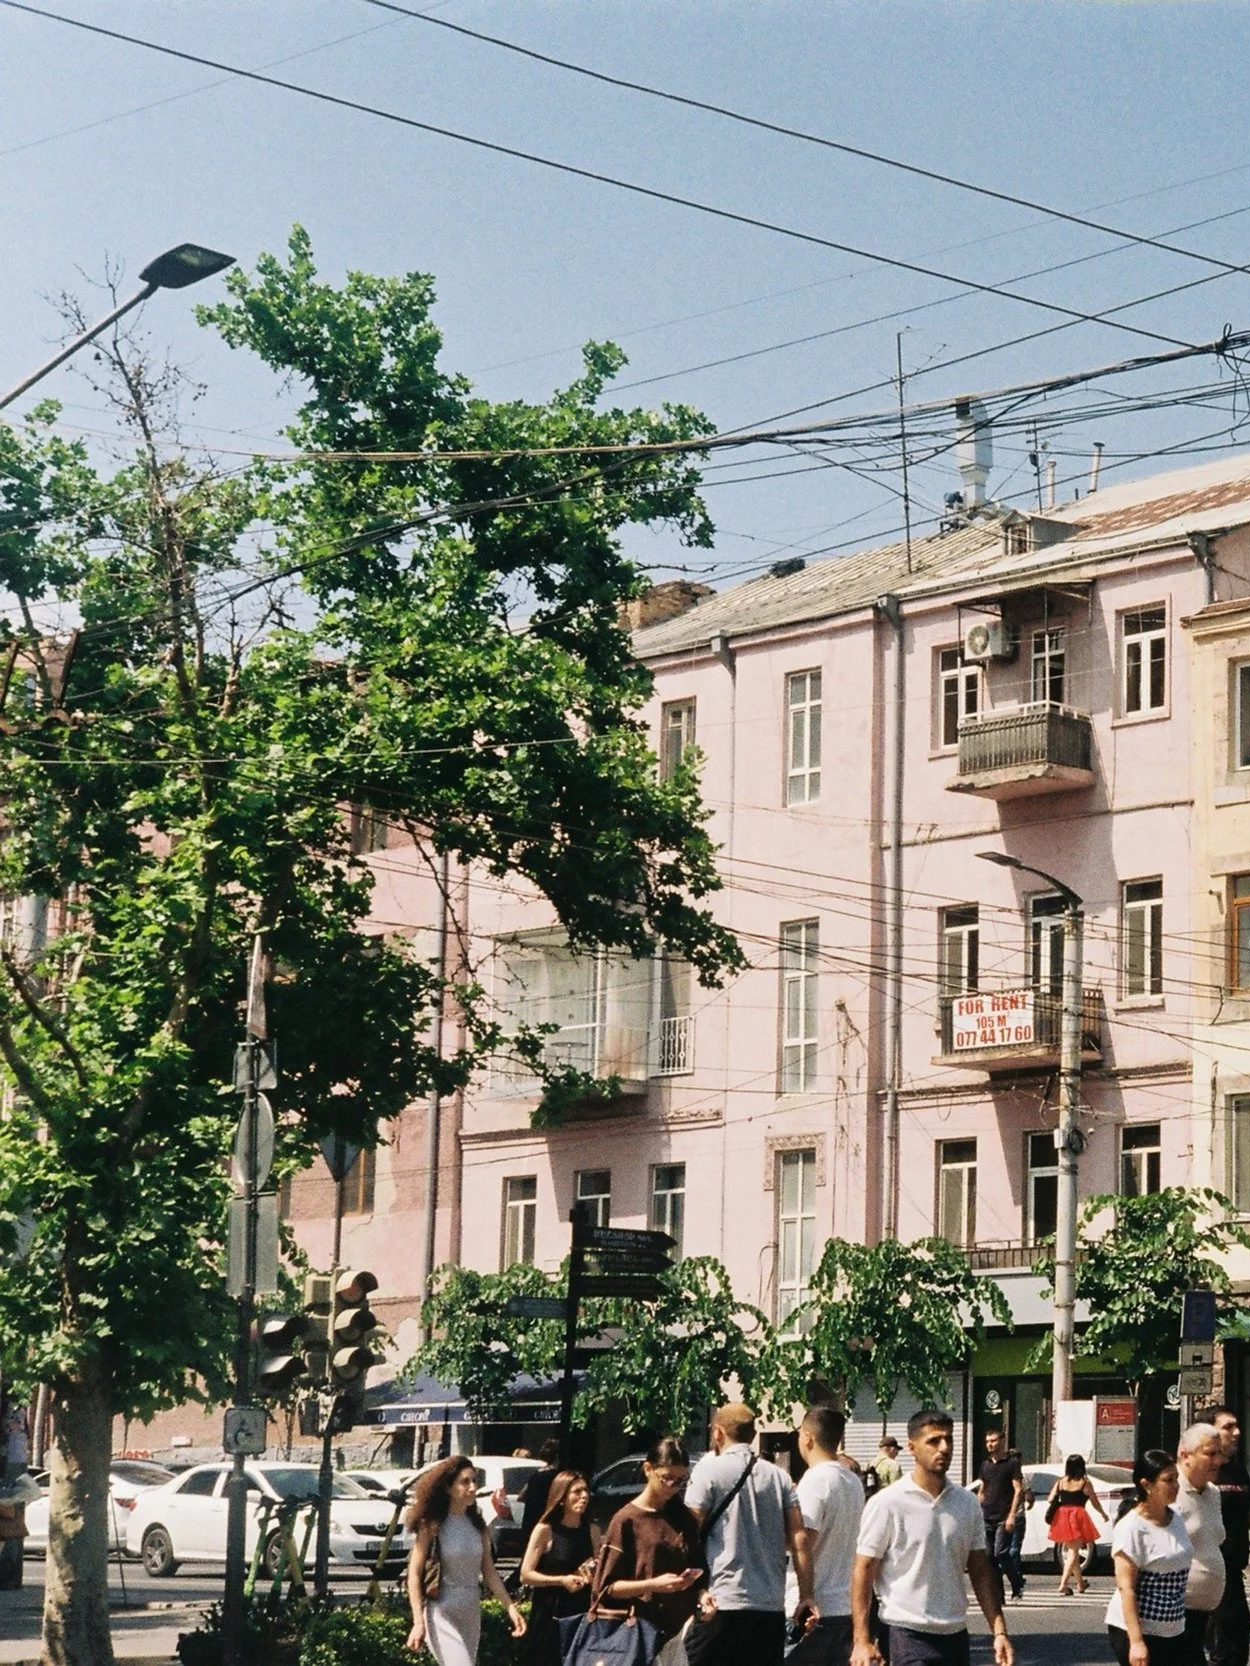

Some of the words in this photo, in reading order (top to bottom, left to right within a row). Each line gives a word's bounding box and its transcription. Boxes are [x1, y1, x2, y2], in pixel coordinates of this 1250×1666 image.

[958, 999, 984, 1016] FOR
[991, 994, 1028, 1011] RENT
[976, 1016, 994, 1029] 105
[957, 1031, 976, 1046] 077
[980, 1029, 996, 1044] 44
[999, 1027, 1011, 1042] 17
[1015, 1025, 1031, 1041] 60
